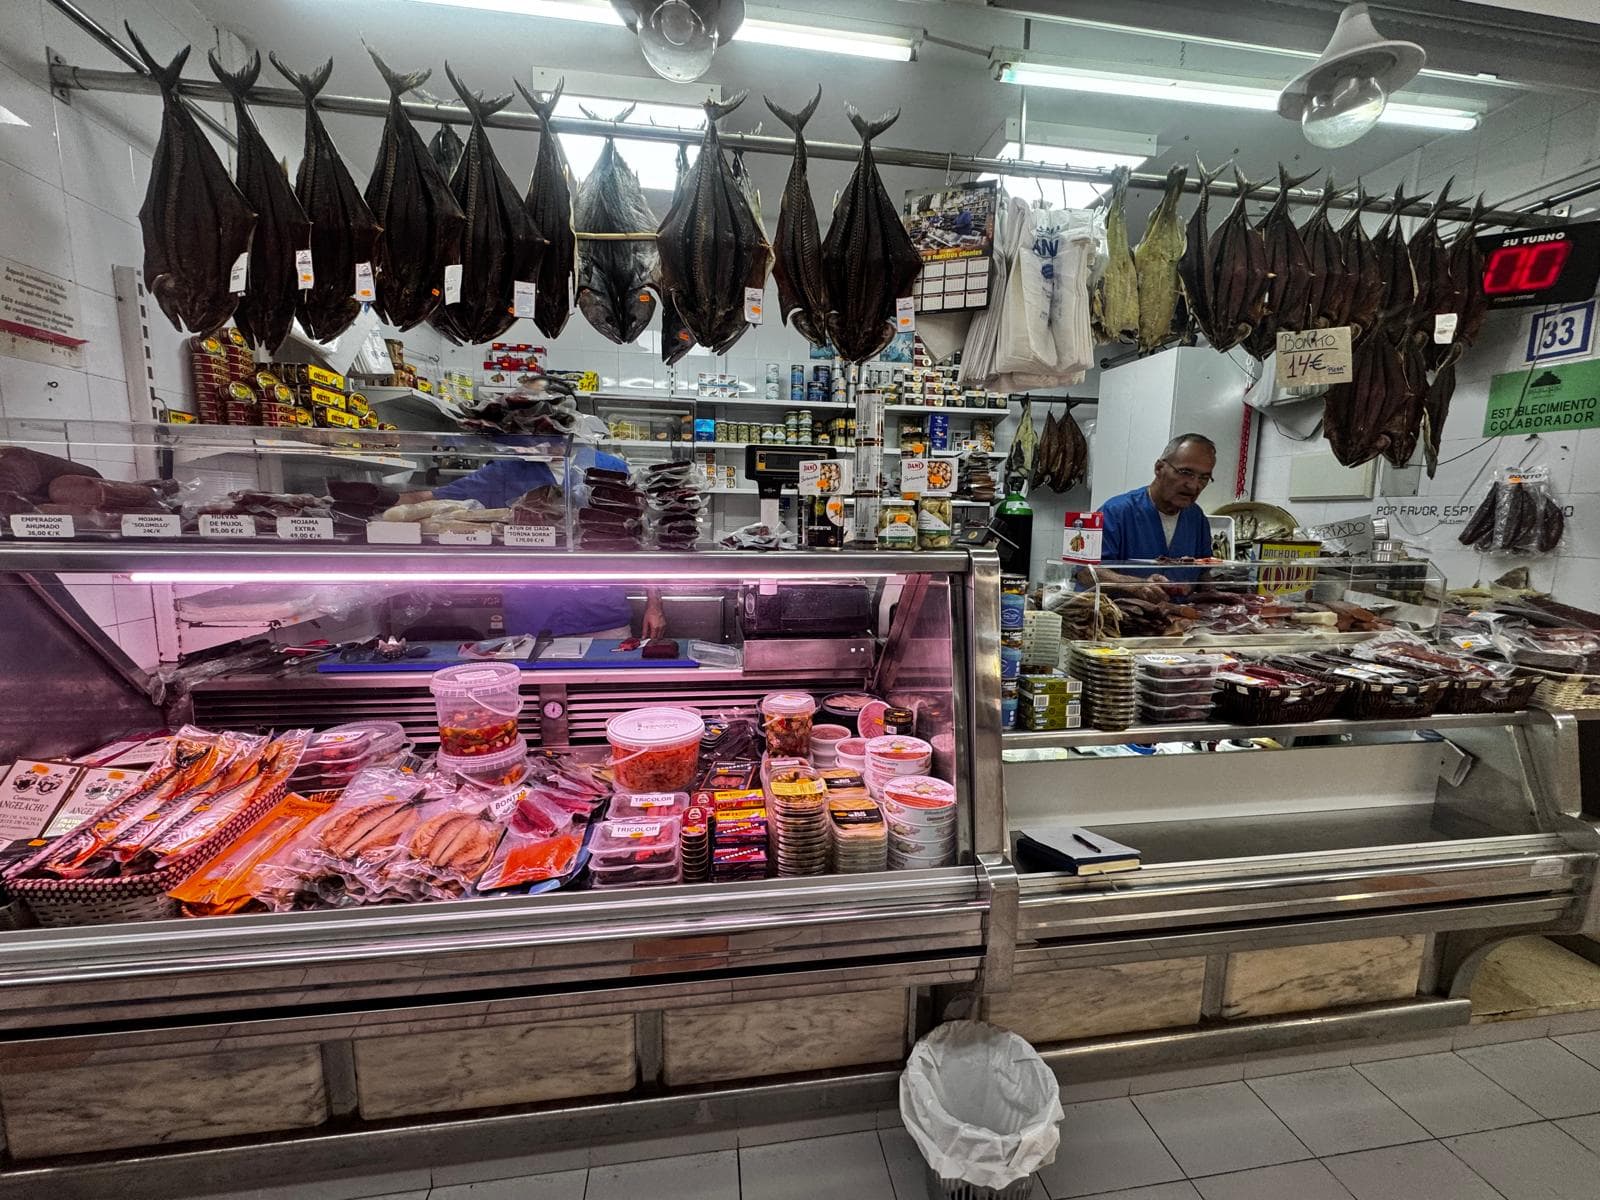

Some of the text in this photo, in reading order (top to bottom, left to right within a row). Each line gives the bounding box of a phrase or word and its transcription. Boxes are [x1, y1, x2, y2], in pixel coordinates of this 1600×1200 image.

[1502, 232, 1565, 247] SU TURNO
[959, 249, 983, 257] clientes
[1543, 316, 1575, 349] 33
[1490, 411, 1594, 432] COLABORADOR
[1376, 505, 1475, 518] POR FAVOR, ESP
[1263, 549, 1300, 559] ANCHOAS
[69, 806, 96, 816] ANGEL
